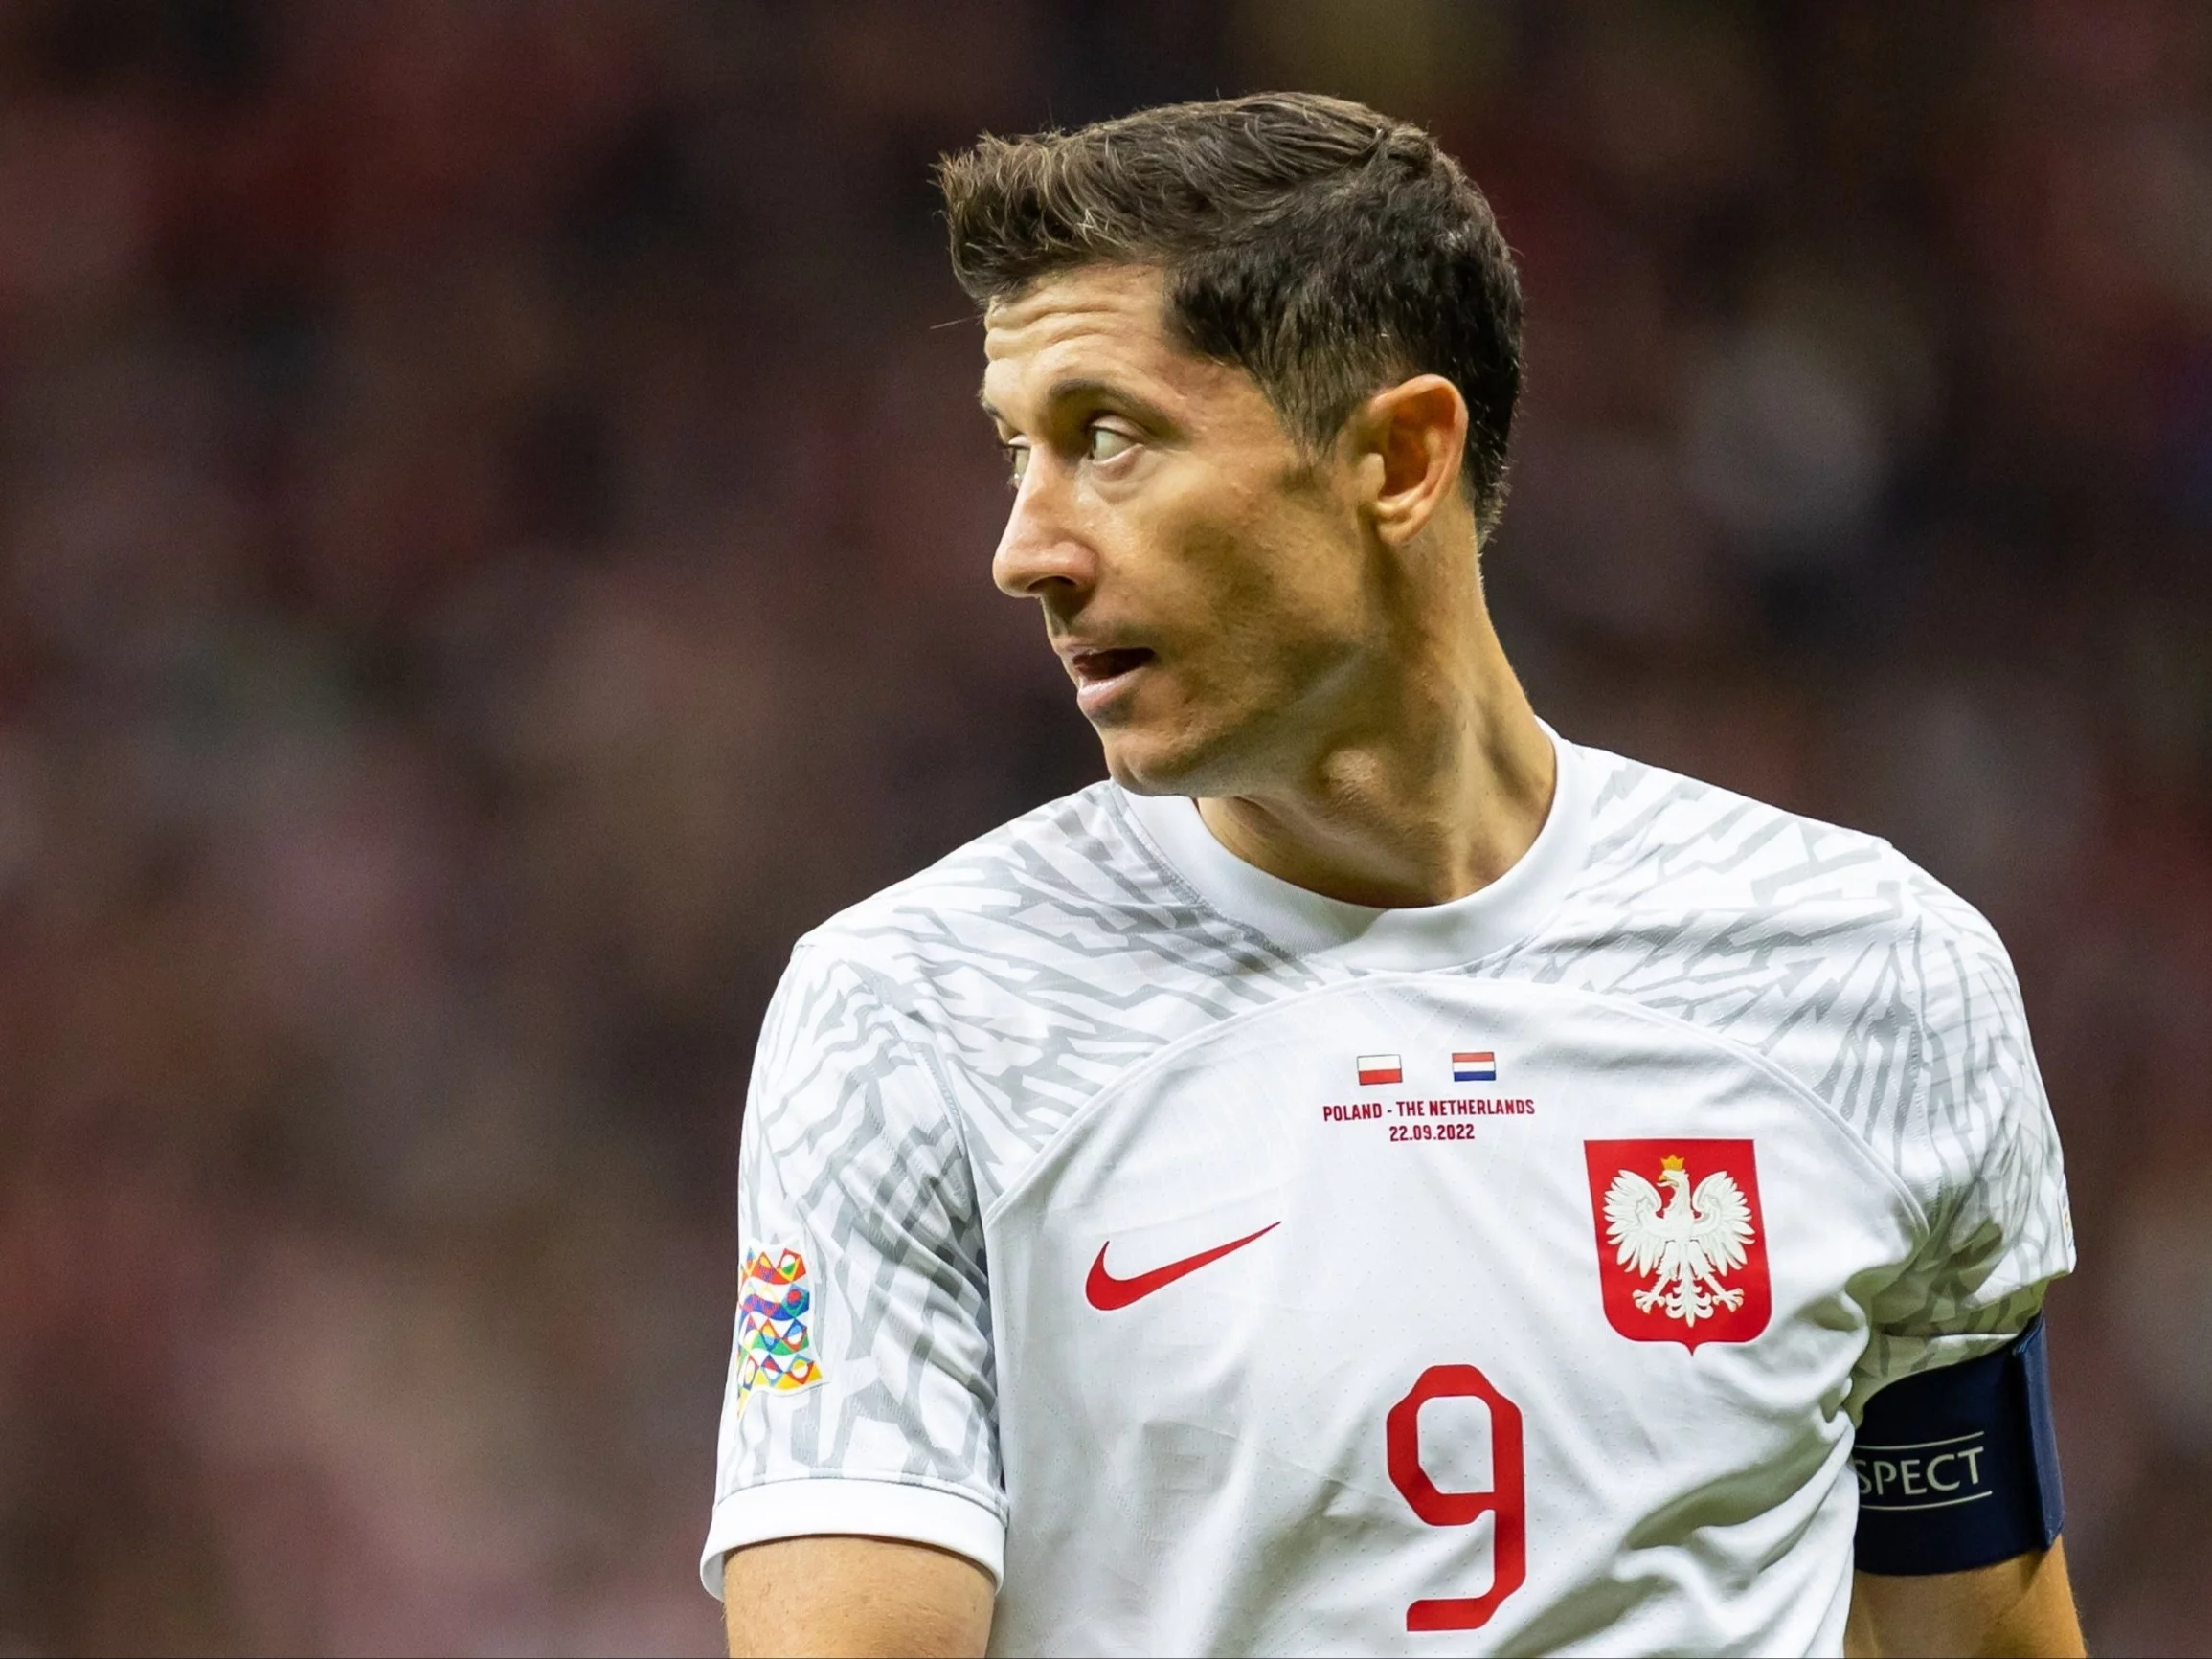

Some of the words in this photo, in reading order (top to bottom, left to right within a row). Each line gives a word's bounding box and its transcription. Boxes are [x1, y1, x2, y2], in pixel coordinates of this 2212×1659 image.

[1322, 1103, 1383, 1122] POLAND
[1396, 1101, 1425, 1117] THE
[1429, 1099, 1536, 1116] NETHERLANDS
[1389, 1124, 1476, 1142] 22.09.2022
[1855, 1446, 1984, 1495] SPECT
[1386, 1363, 1526, 1632] 9
